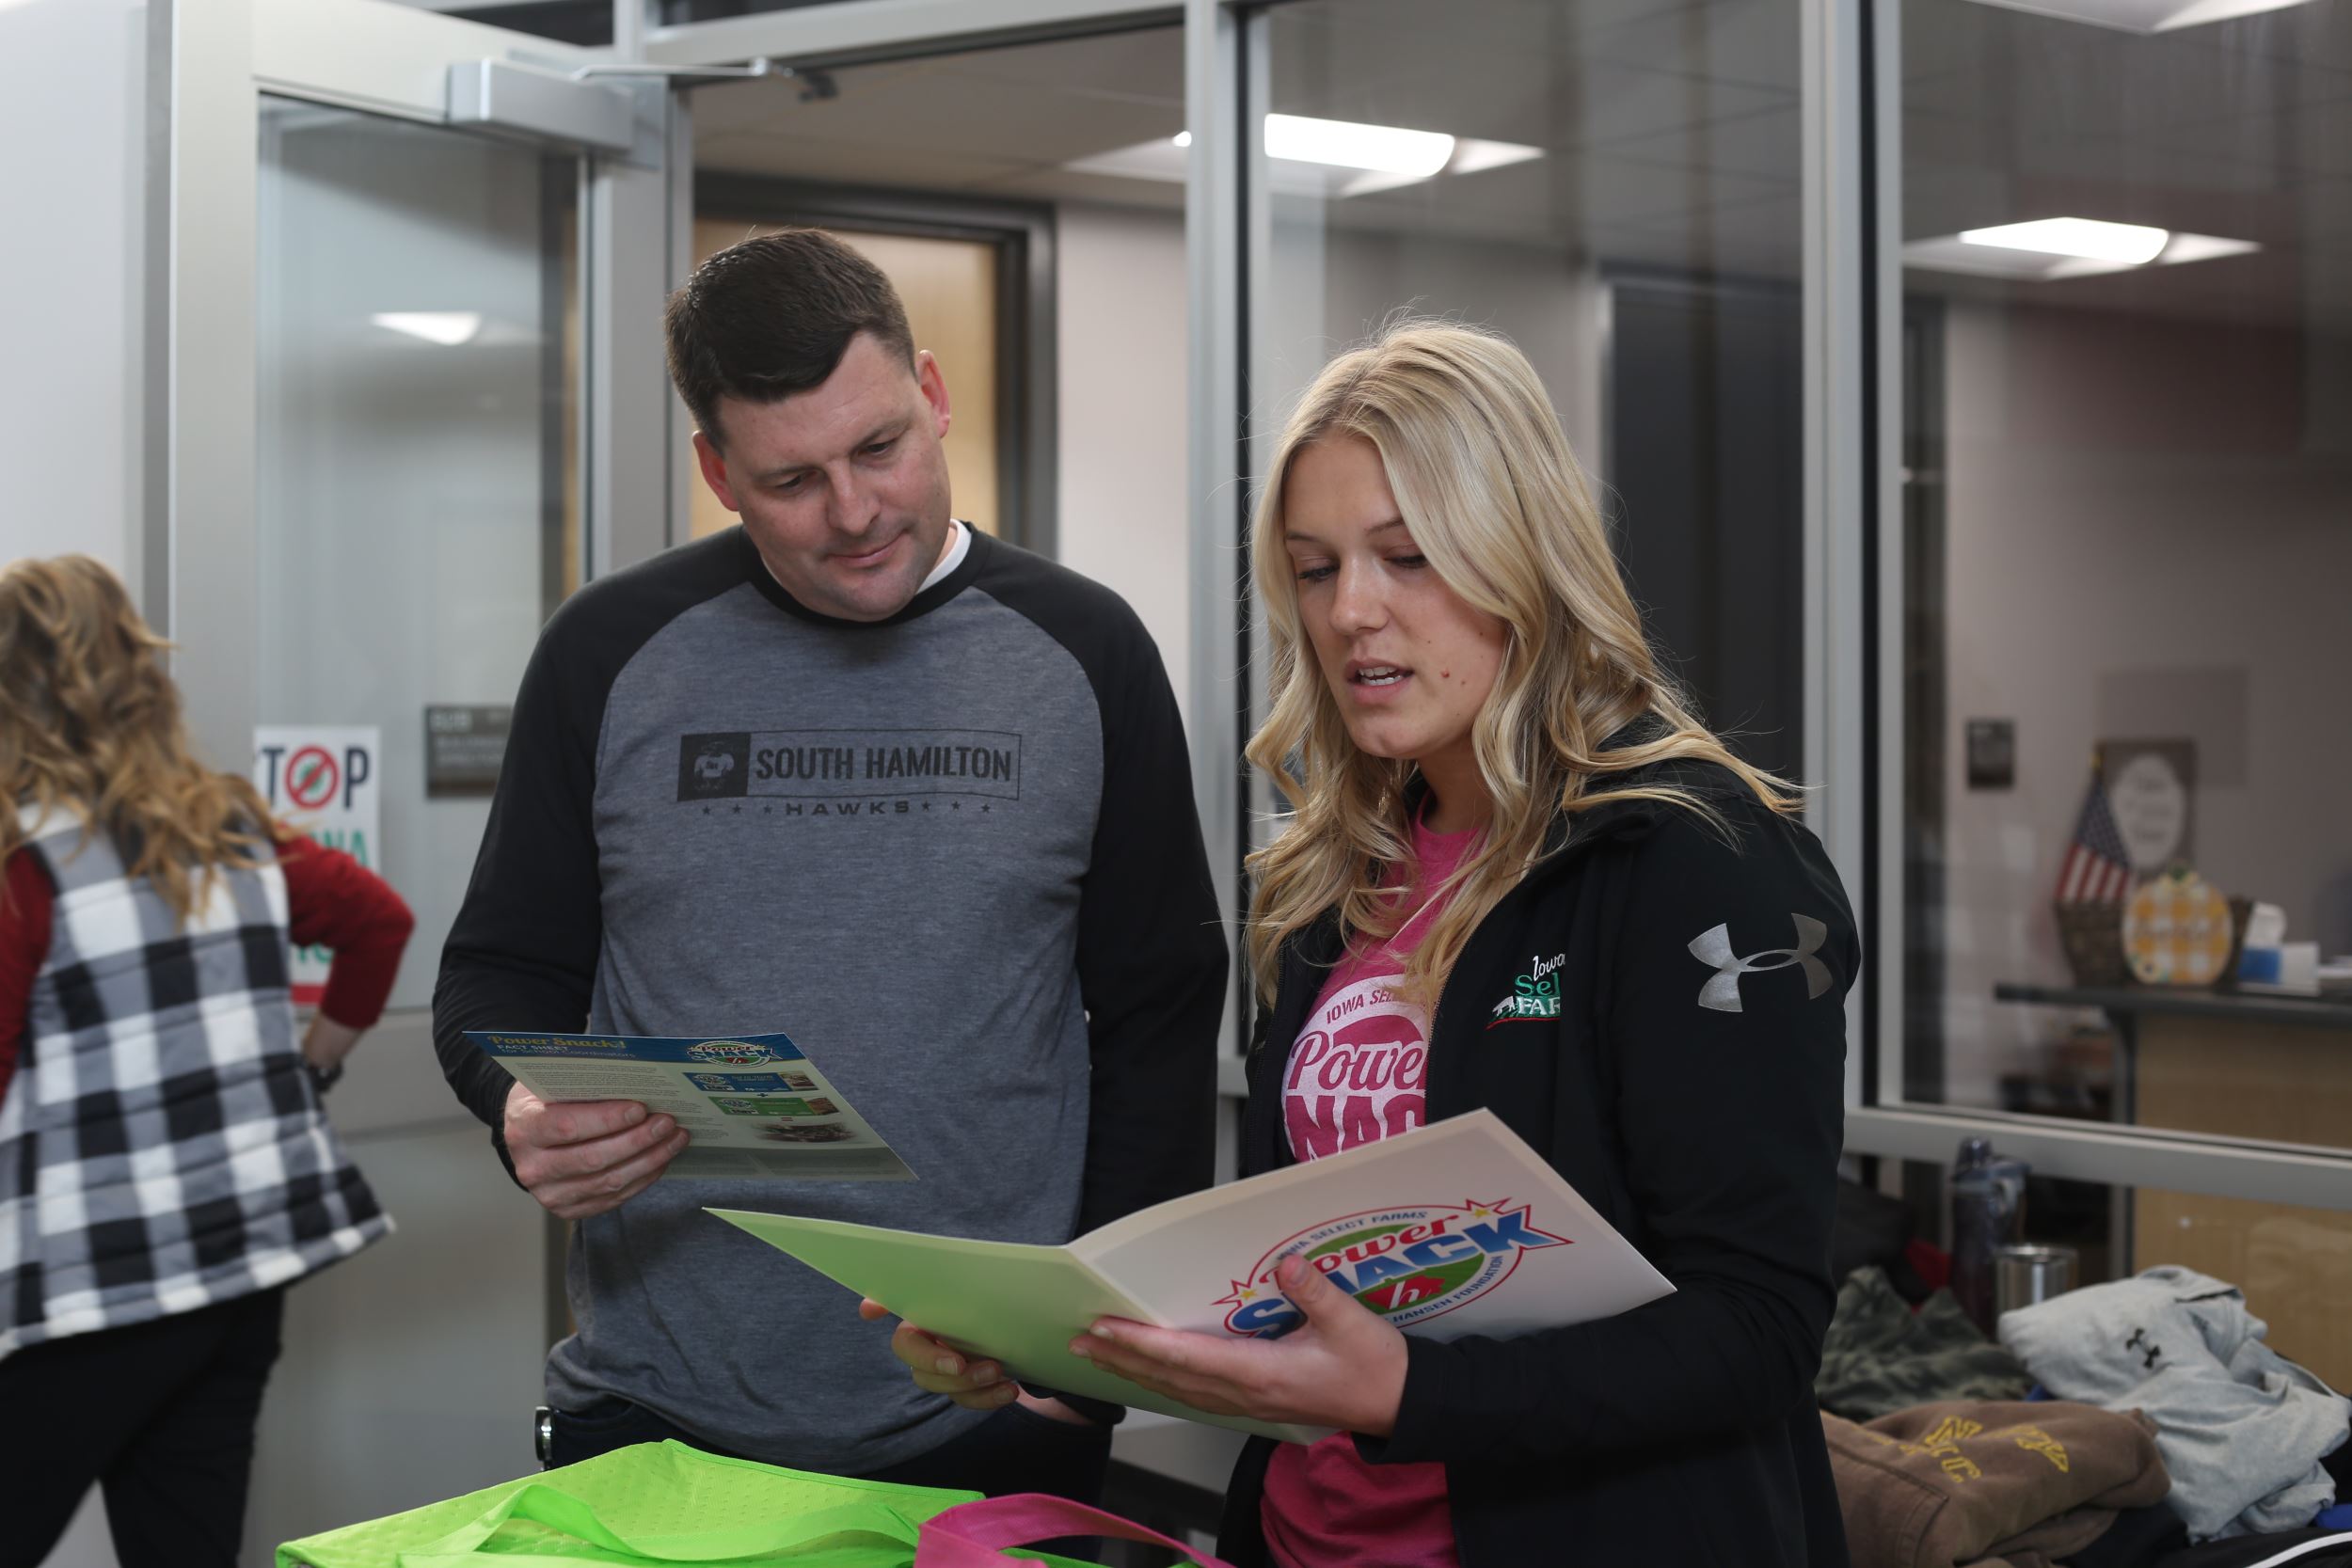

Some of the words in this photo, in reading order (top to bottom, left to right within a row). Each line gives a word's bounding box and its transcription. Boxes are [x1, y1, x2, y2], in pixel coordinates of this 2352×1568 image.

[756, 746, 852, 780] SOUTH
[866, 745, 1011, 782] HAMILTON
[786, 800, 910, 816] HAWKS
[1533, 953, 1565, 981] Iowa
[1327, 993, 1364, 1024] IOWA
[487, 1036, 549, 1045] Power
[1311, 1219, 1366, 1240] SELECT
[1372, 1212, 1428, 1224] FARMS
[1392, 1298, 1453, 1323] HANSEN
[1452, 1256, 1503, 1300] FOUNDATION
